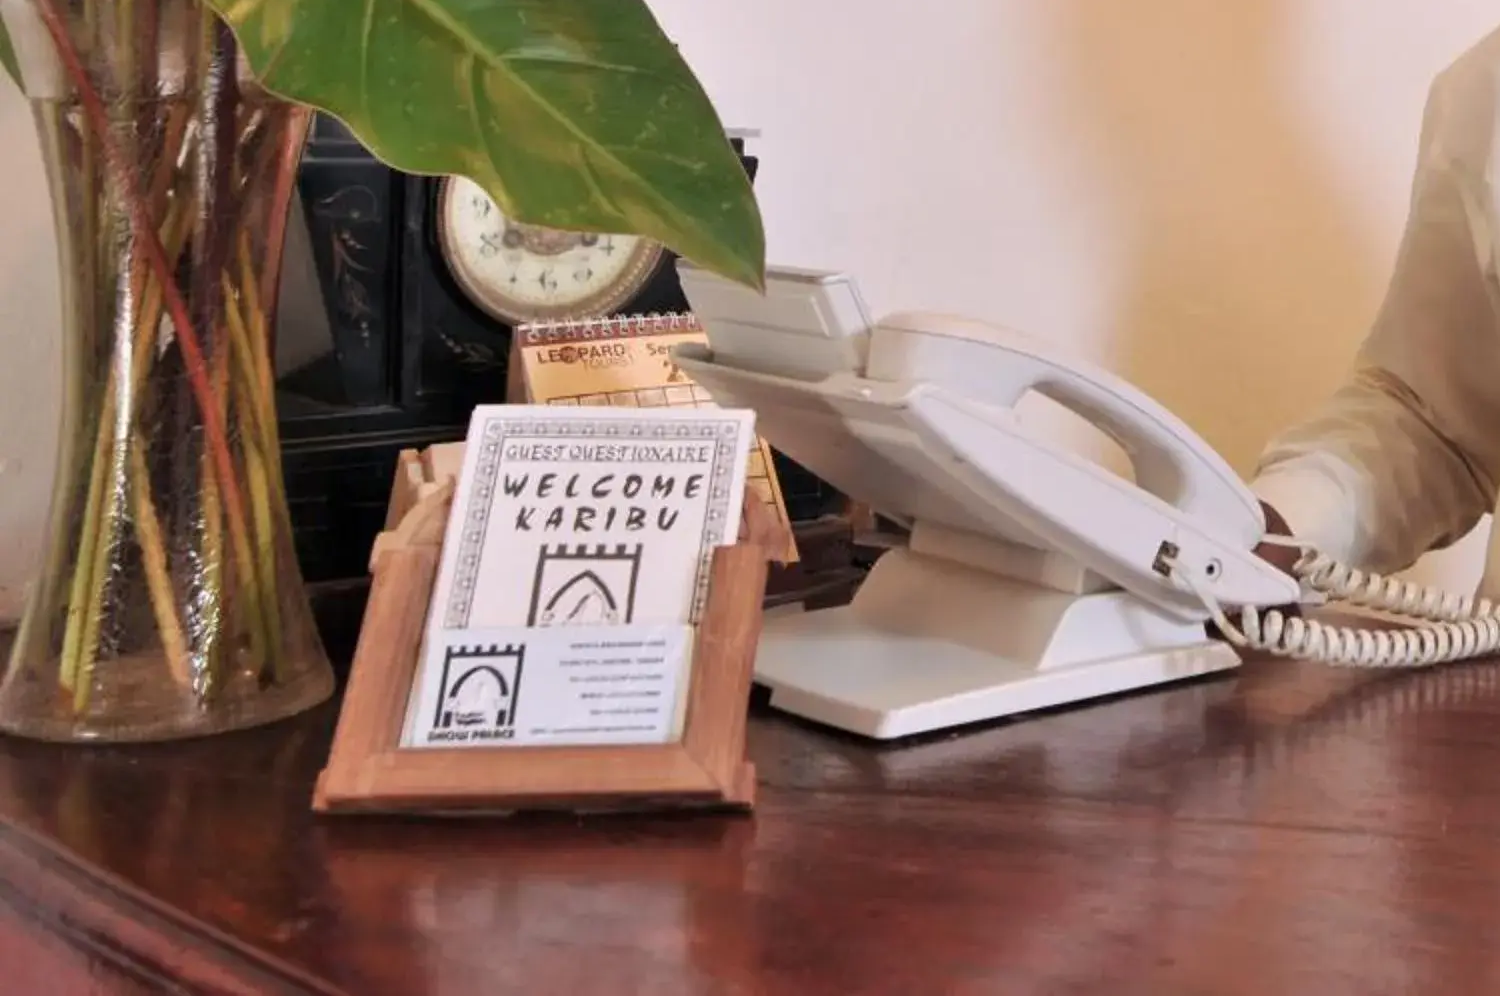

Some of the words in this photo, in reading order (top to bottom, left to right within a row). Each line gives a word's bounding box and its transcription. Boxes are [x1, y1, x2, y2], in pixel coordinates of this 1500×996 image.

[537, 344, 625, 364] LEOPARD
[506, 444, 566, 462] GUEST
[569, 444, 710, 463] QUESTIONAIRE
[503, 473, 705, 499] WELCOME
[514, 506, 680, 533] KARIBU
